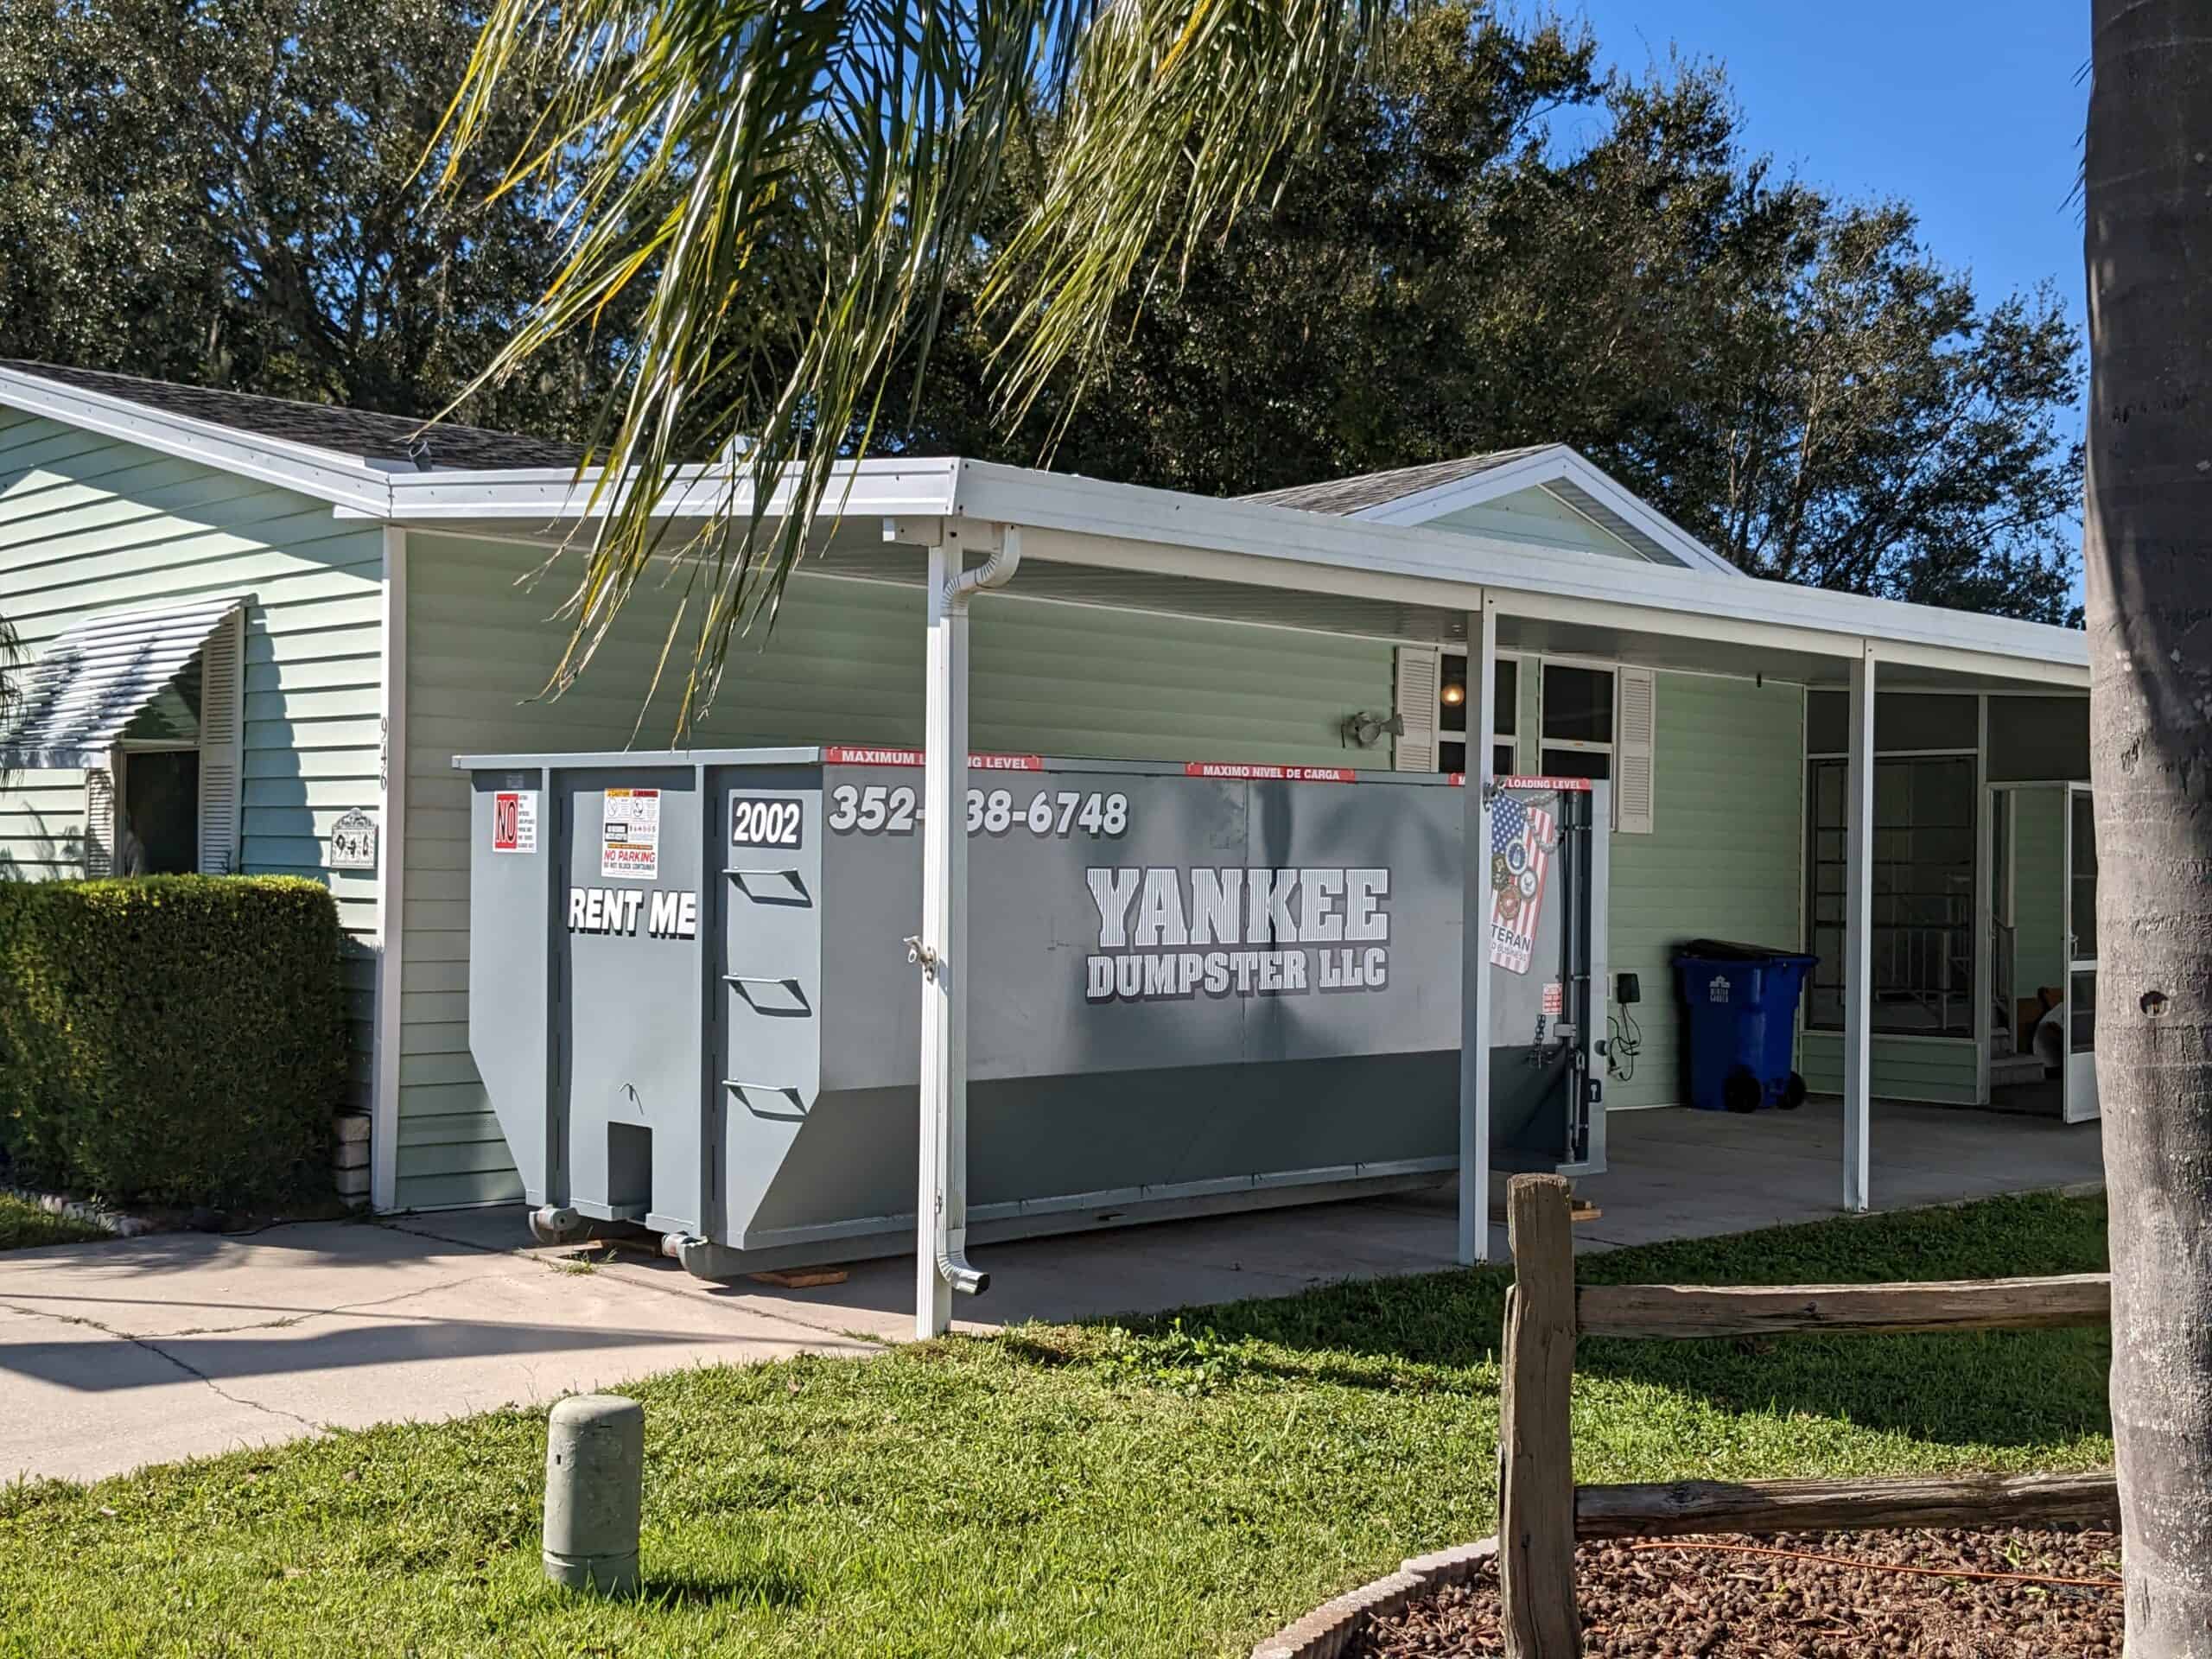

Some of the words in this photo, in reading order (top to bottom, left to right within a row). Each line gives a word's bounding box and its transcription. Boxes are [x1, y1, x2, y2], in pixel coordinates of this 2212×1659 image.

[842, 750, 914, 765] MAXIMUM
[986, 757, 1028, 770] LEVEL
[1203, 766, 1249, 777] MAXIMO
[1253, 767, 1283, 778] NIVEL
[1286, 769, 1300, 779] DE
[1304, 769, 1340, 779] CARGA
[1508, 779, 1549, 789] LOADING
[1553, 779, 1581, 790] LEVEL
[497, 800, 517, 842] NO
[733, 801, 800, 844] 2002
[829, 785, 1128, 836] 352-38-6748
[604, 849, 616, 861] NO
[618, 850, 656, 863] PARKING
[568, 887, 643, 935] RENT
[648, 891, 696, 939] ME
[1085, 867, 1389, 948] YANKEE
[1491, 924, 1530, 952] TERAN
[1086, 950, 1308, 998] DUMPSTER
[1319, 948, 1388, 989] LLC
